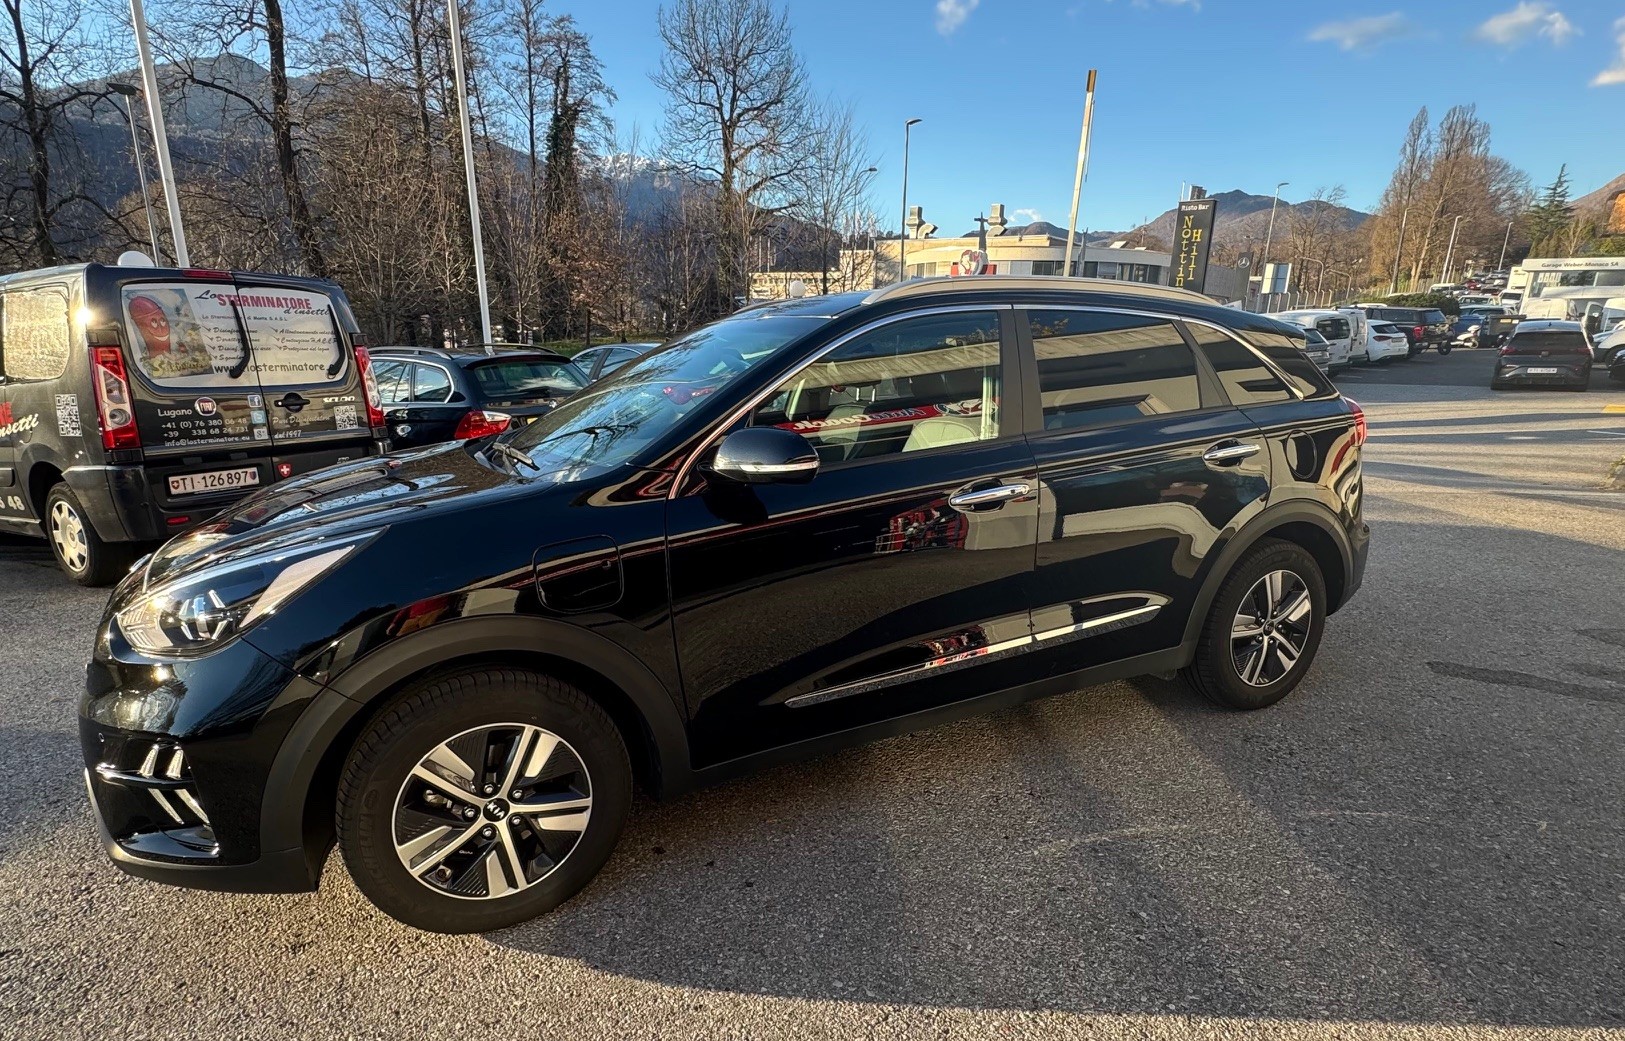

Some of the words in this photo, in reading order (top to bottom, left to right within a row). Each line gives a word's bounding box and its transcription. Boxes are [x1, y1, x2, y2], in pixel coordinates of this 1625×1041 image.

[1187, 229, 1202, 280] Hill
[194, 289, 217, 300] Lo
[217, 293, 312, 310] STERMINATORE
[157, 408, 193, 418] Lugano
[199, 402, 213, 412] FIAT
[161, 421, 177, 429] +41
[180, 420, 192, 429] (0)
[192, 428, 207, 436] 338
[7, 495, 25, 511] 48
[486, 801, 505, 819] KIA
